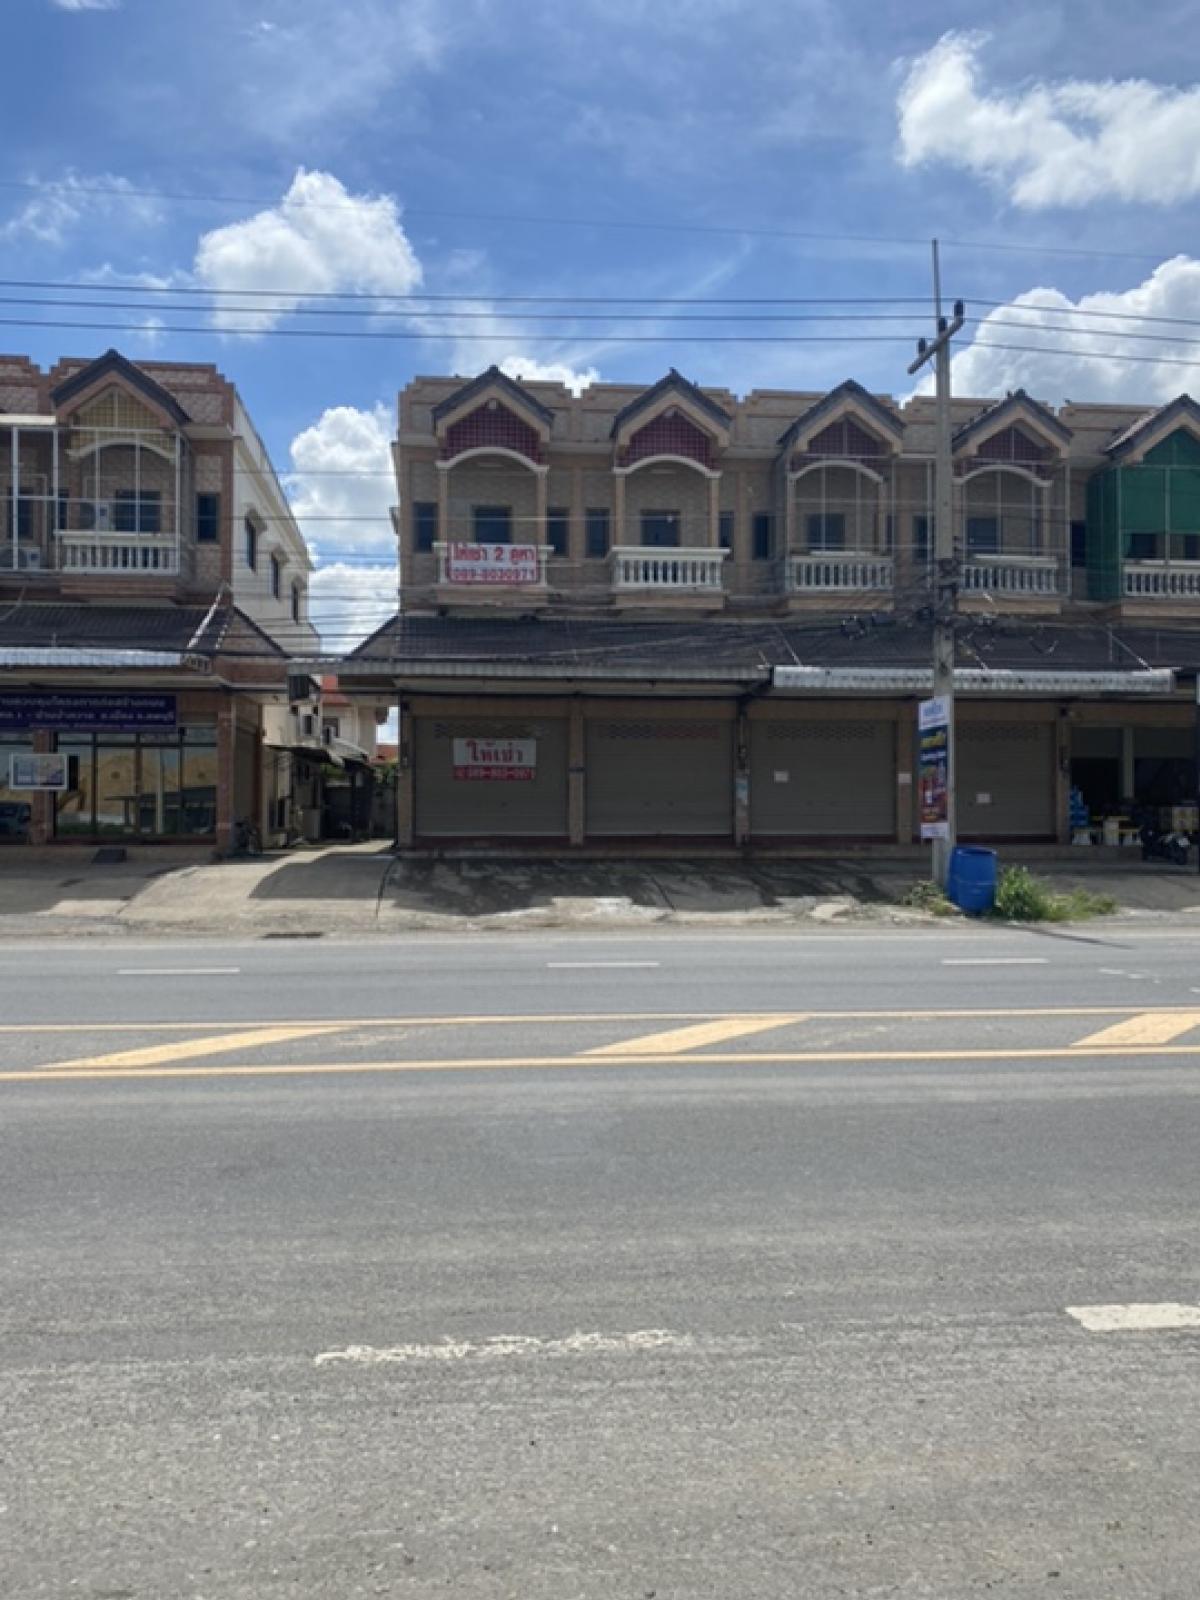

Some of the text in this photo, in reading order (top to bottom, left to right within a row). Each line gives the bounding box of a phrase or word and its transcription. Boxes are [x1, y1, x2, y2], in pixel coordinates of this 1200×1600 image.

[494, 546, 504, 562] 2
[464, 740, 523, 762] ให้เช่า
